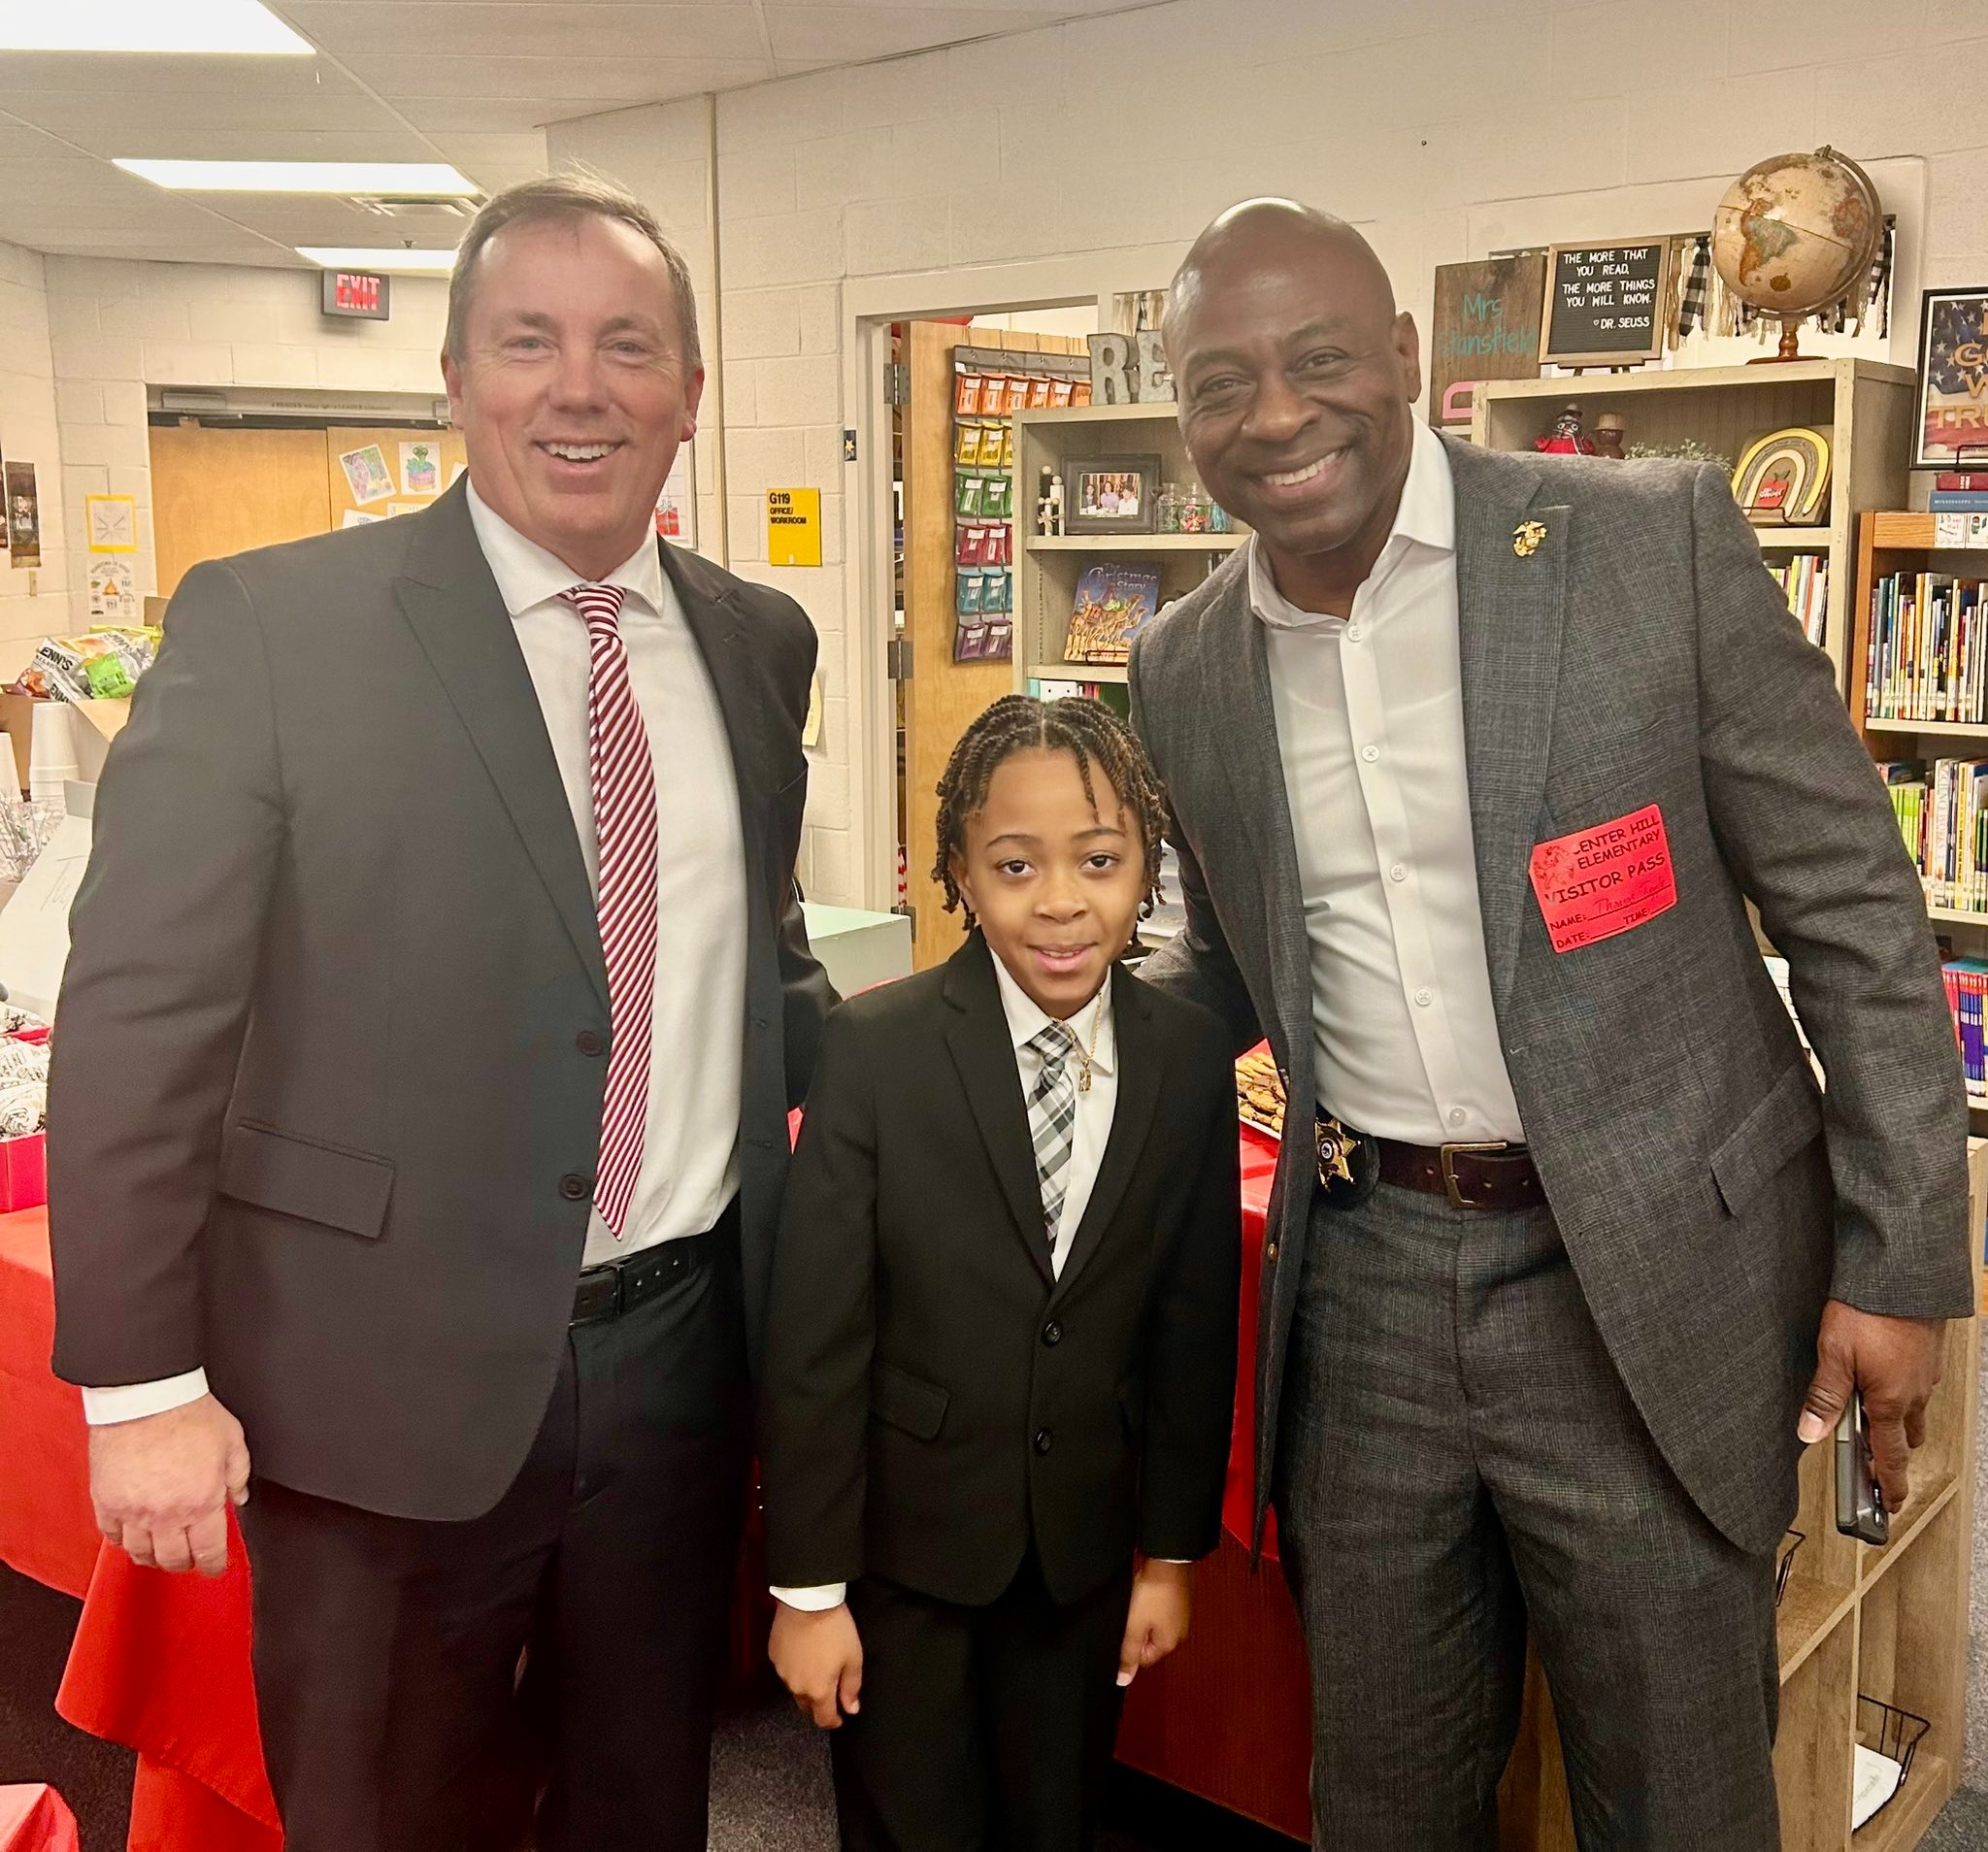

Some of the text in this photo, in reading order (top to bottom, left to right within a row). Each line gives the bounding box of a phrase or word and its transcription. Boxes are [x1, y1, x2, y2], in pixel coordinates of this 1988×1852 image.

[1563, 248, 1648, 264] THE MORE THAT
[1576, 266, 1594, 277] YOU
[336, 274, 381, 311] EXIT
[1562, 279, 1655, 294] THE MORE THINGS
[1463, 292, 1504, 322] Mrs
[1566, 292, 1651, 308] YOU WILL KNOW.
[1600, 316, 1650, 329] DR. SEUSS
[1954, 342, 1988, 367] G
[1928, 406, 1988, 429] TR
[769, 492, 791, 504] G119
[1088, 567, 1158, 584] Christmas
[1117, 580, 1146, 592] Story
[38, 646, 74, 671] ENN'S
[1574, 814, 1661, 855] ENTER HILL
[1577, 829, 1661, 870] ELEMENTARY
[1628, 851, 1666, 879] PASS
